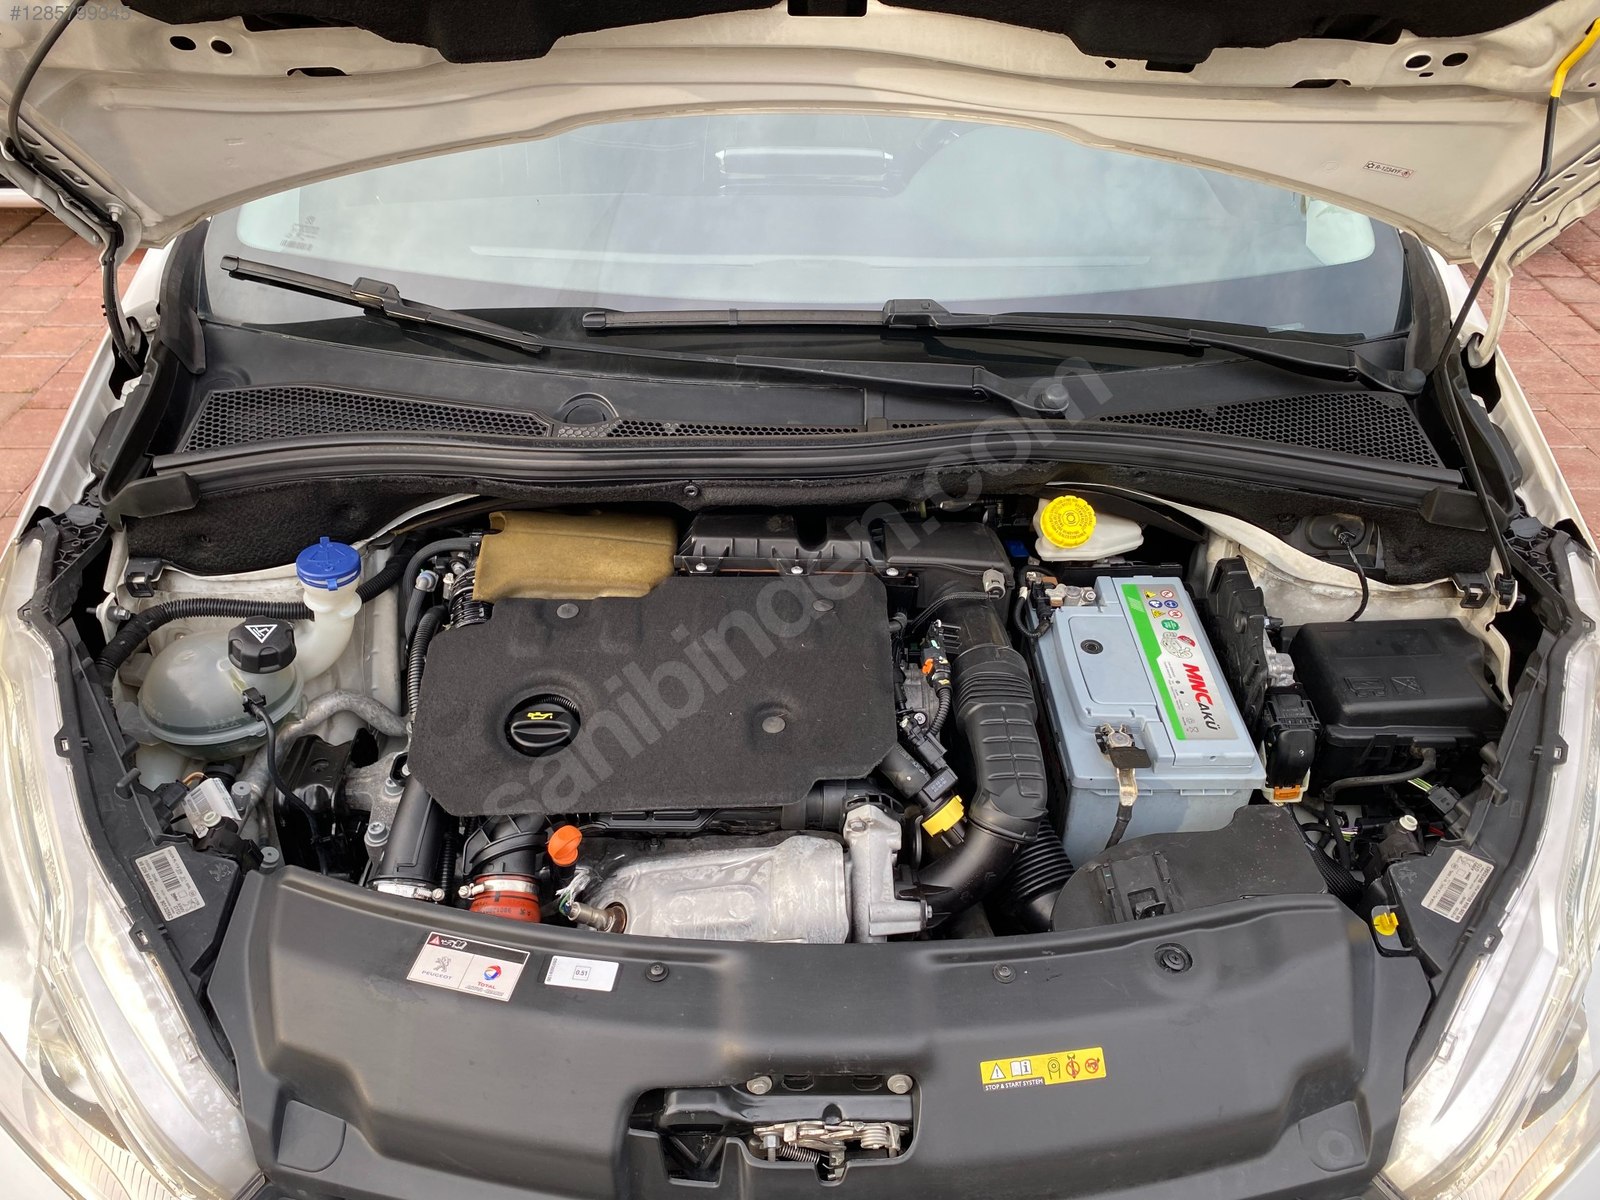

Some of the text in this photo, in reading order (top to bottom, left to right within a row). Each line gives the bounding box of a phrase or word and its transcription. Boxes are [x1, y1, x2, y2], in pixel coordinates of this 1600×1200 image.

[421, 970, 452, 980] PEUGEOT
[477, 981, 496, 989] TOTAL
[1005, 1081, 1021, 1089] START
[1023, 1078, 1044, 1087] SYSTEM
